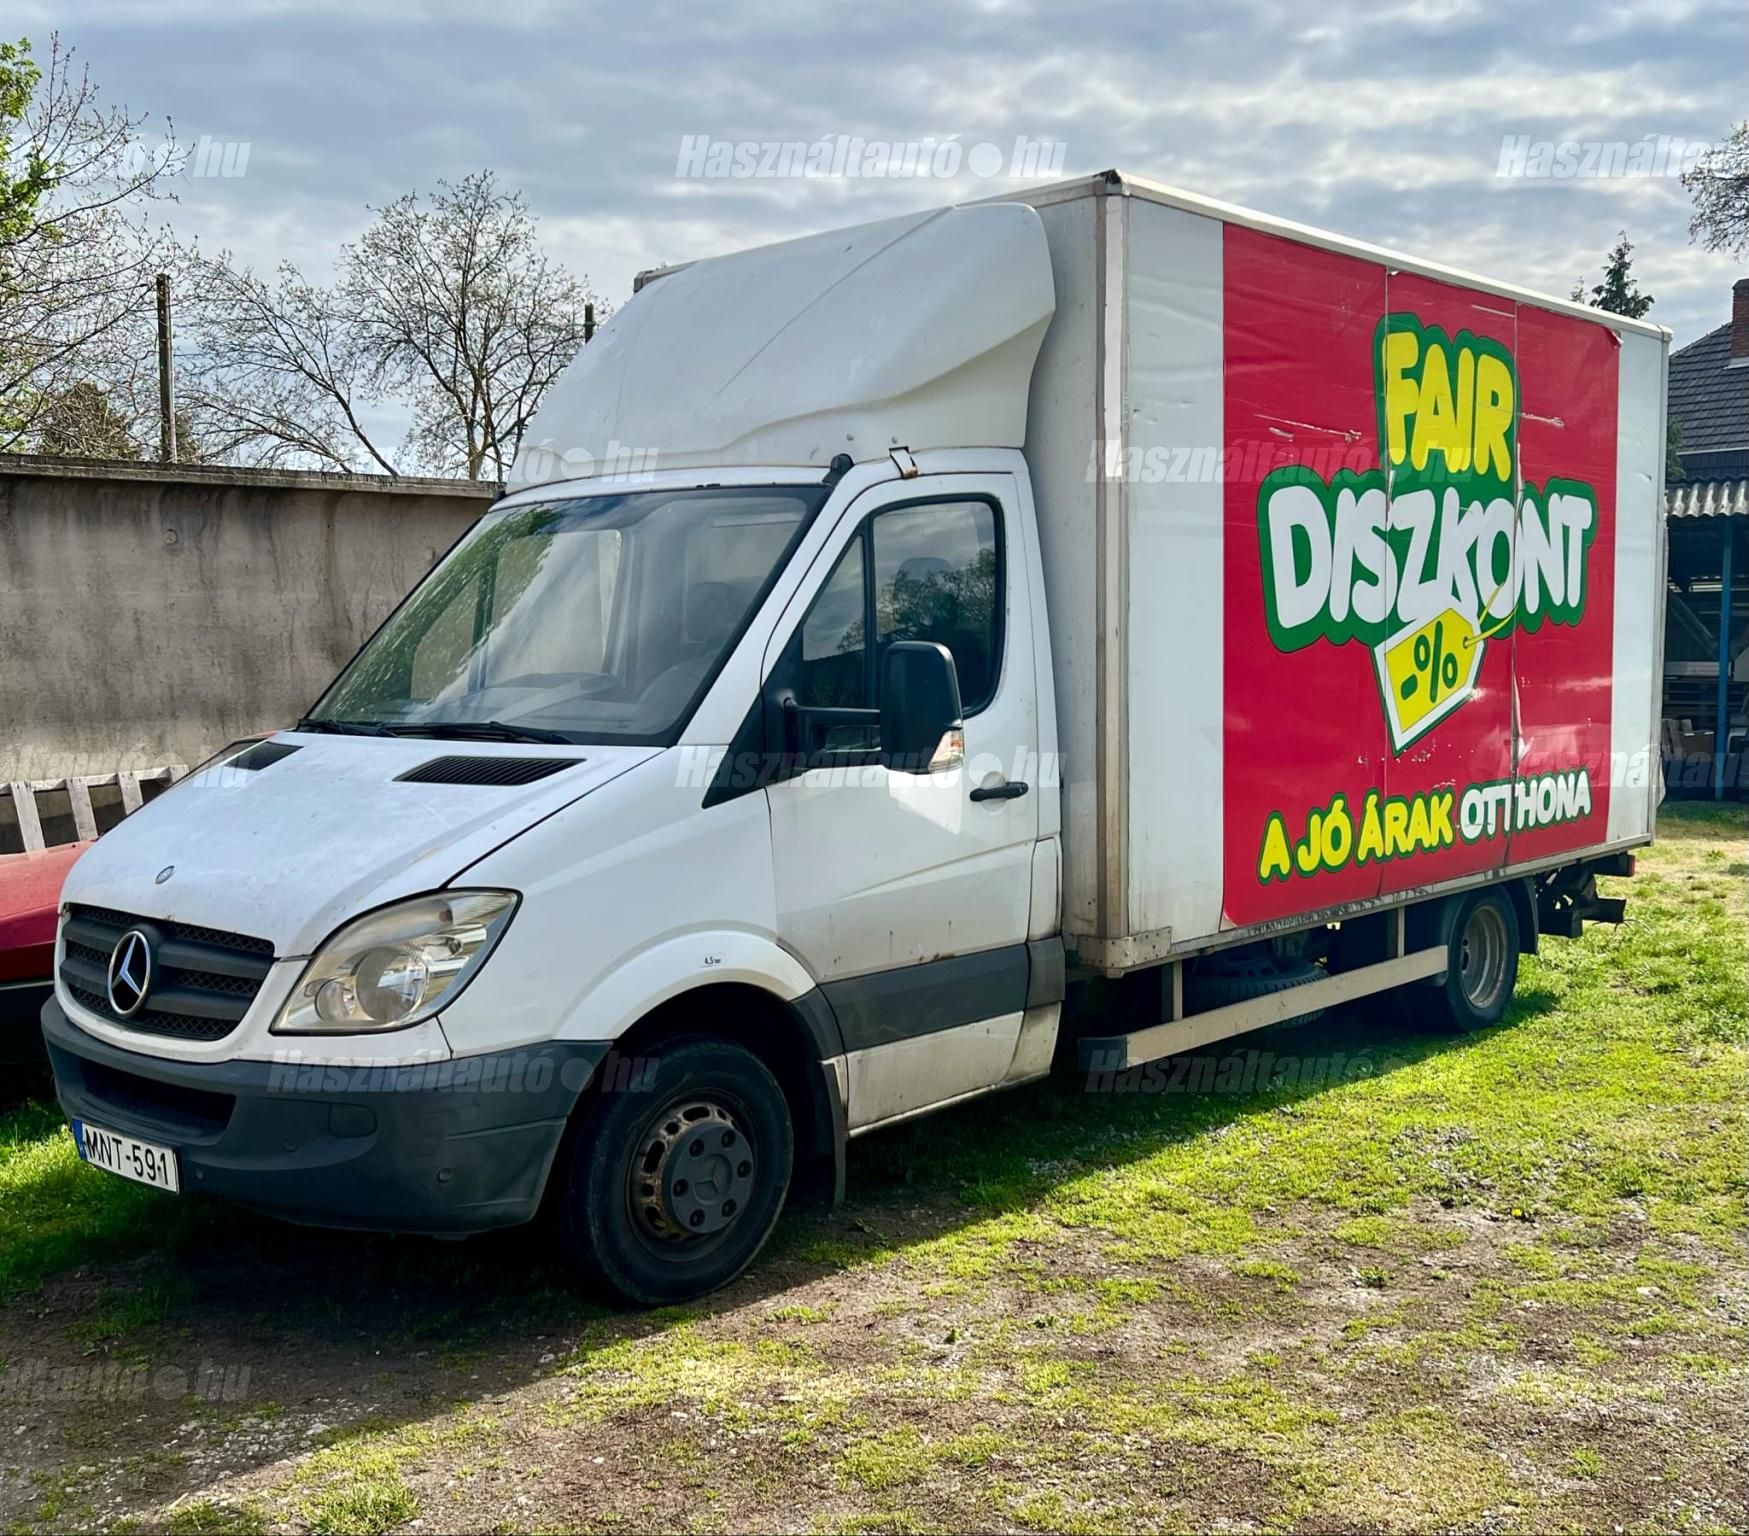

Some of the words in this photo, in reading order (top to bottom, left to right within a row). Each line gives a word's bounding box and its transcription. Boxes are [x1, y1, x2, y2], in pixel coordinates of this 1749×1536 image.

[1382, 332, 1514, 482] FAIR
[1268, 485, 1593, 629] DISZKONT
[1259, 818, 1291, 879] A
[1297, 799, 1353, 872] JÓ
[1358, 793, 1454, 862] ÁRAK
[1460, 771, 1592, 840] OTTHONA
[85, 1128, 168, 1186] MNT-591
